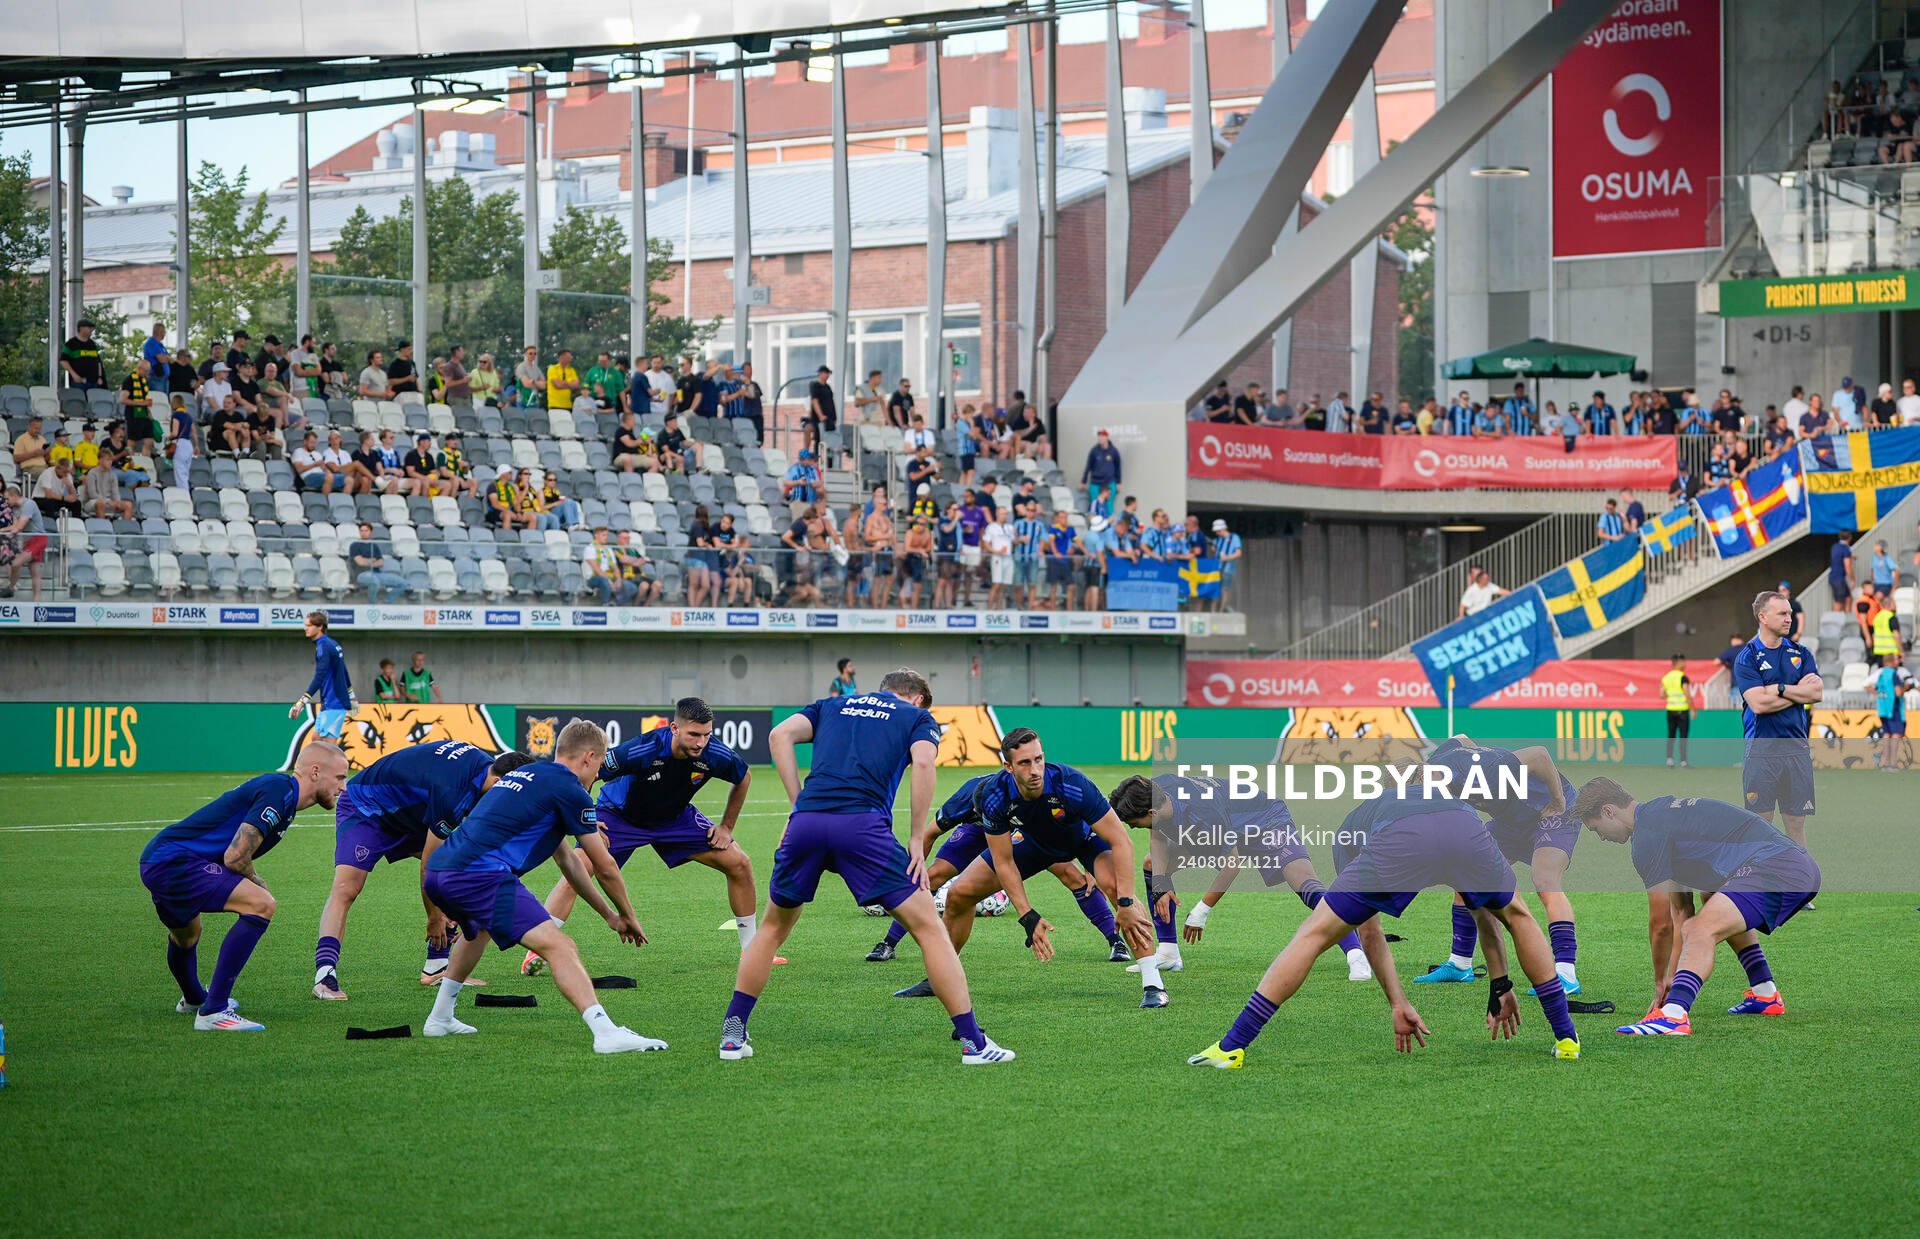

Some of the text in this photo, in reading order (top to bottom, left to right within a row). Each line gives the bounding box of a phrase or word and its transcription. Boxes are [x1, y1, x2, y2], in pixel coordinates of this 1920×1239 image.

[1611, 0, 1678, 16] oraan
[1581, 168, 1693, 202] OSUMA
[1765, 275, 1907, 309] PARASTA AIKAA YHDESSÄ
[1770, 325, 1811, 343] D1-5
[1223, 442, 1384, 469] OSUMA Suoraan sydämeen.
[1444, 453, 1665, 472] OSUMA Suoraan sydämeen.
[106, 610, 140, 619] Duunitori
[168, 607, 207, 619] STARK
[223, 610, 257, 621] Mynthon
[271, 608, 303, 619] SVEA
[382, 612, 412, 621] Duunitori
[438, 610, 473, 621] STARK
[531, 610, 561, 622] SVEA
[683, 611, 715, 622] STARK
[768, 612, 796, 623] SVEA
[907, 614, 937, 624] STARK
[985, 614, 1010, 625] SVEA
[1112, 616, 1140, 626] STARK
[1428, 600, 1537, 671] SEKTION
[1464, 634, 1531, 682] STIM
[1240, 678, 1320, 696] OSUMA
[1377, 678, 1437, 698] Suor
[846, 696, 897, 710] MOBILL
[840, 706, 891, 721] stadium
[55, 705, 138, 768] ILVES
[1121, 710, 1178, 761] ILVES
[1556, 710, 1625, 762] ILVES
